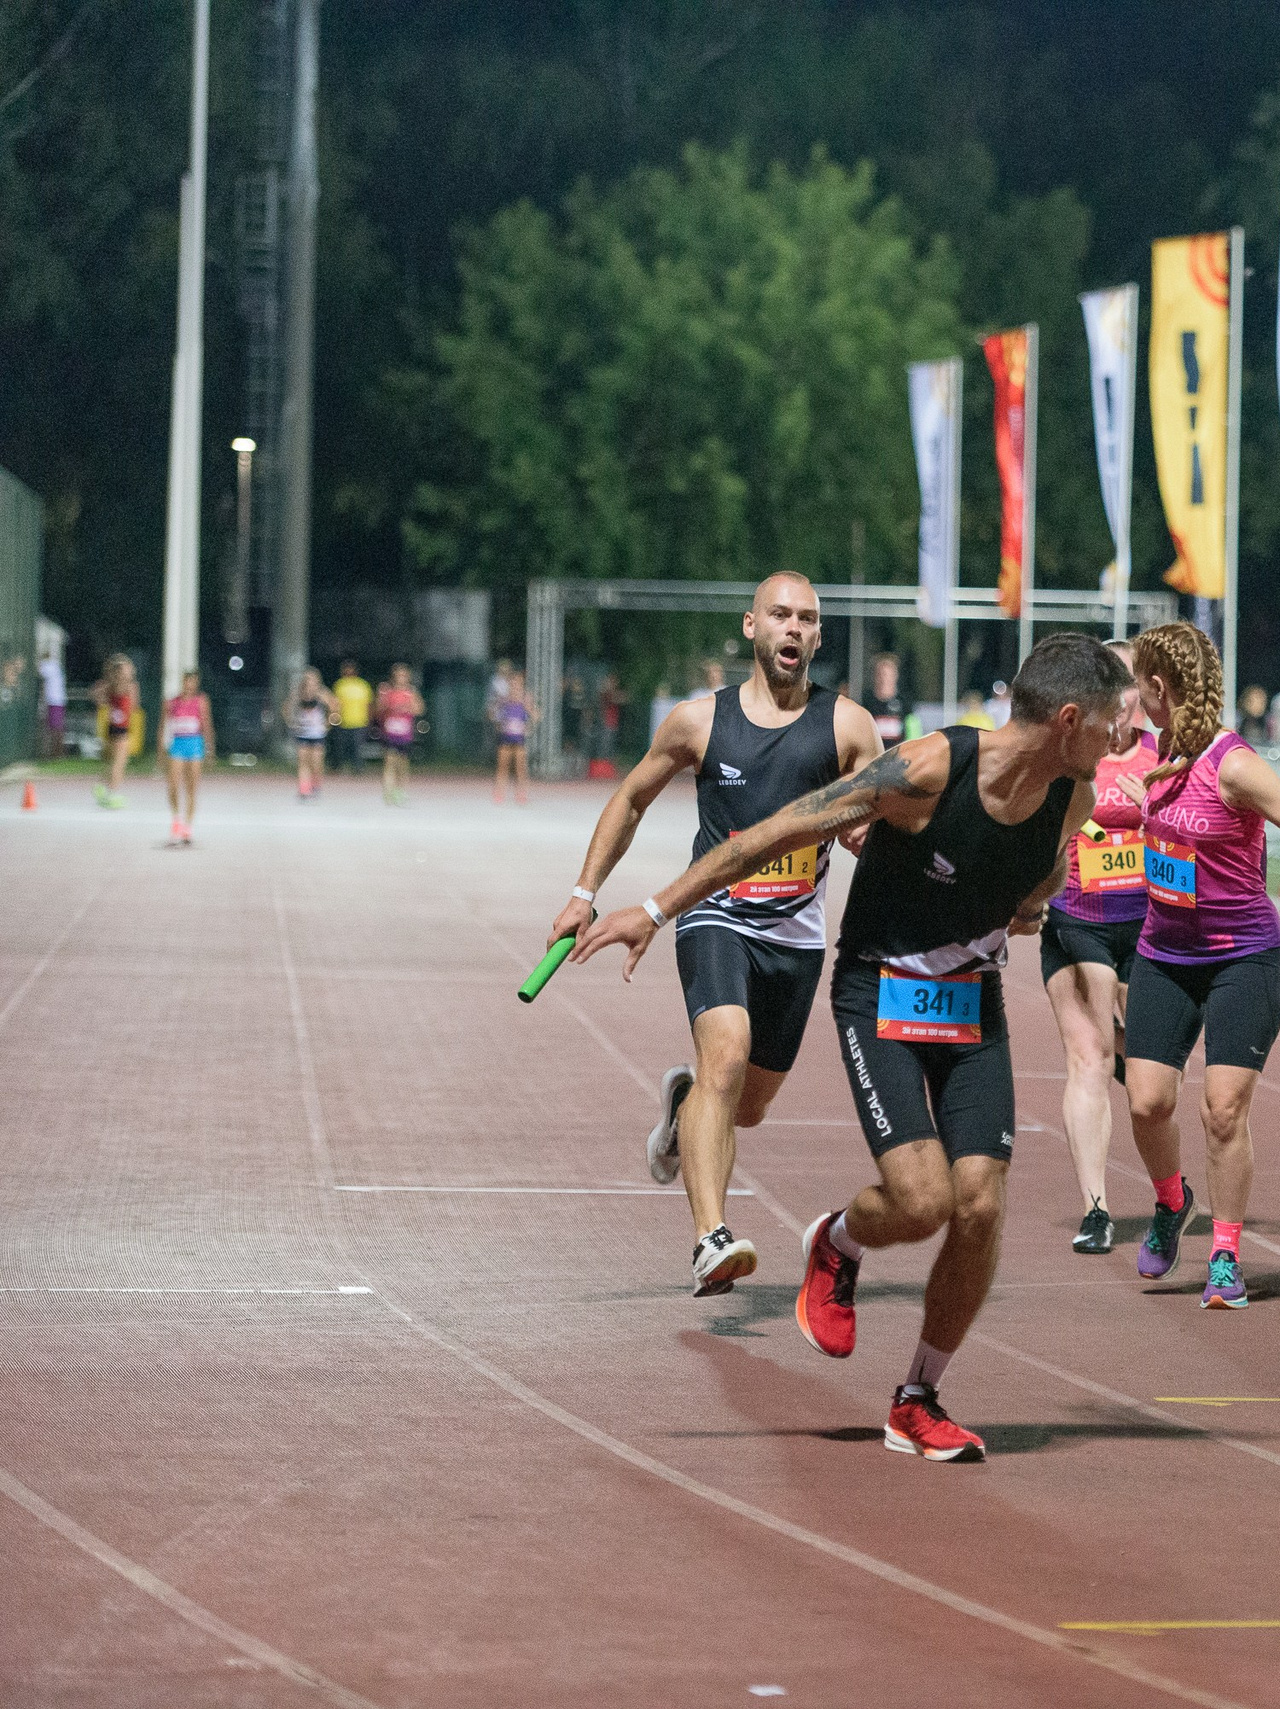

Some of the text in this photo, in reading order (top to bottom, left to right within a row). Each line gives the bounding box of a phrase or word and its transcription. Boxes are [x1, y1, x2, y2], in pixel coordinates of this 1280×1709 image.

[802, 861, 809, 873] 2
[1102, 850, 1136, 871] 340
[1151, 858, 1175, 884] 340
[1180, 876, 1187, 887] 3
[912, 988, 970, 1017] 341 3
[846, 1026, 892, 1137] LOCAL ATHLETES
